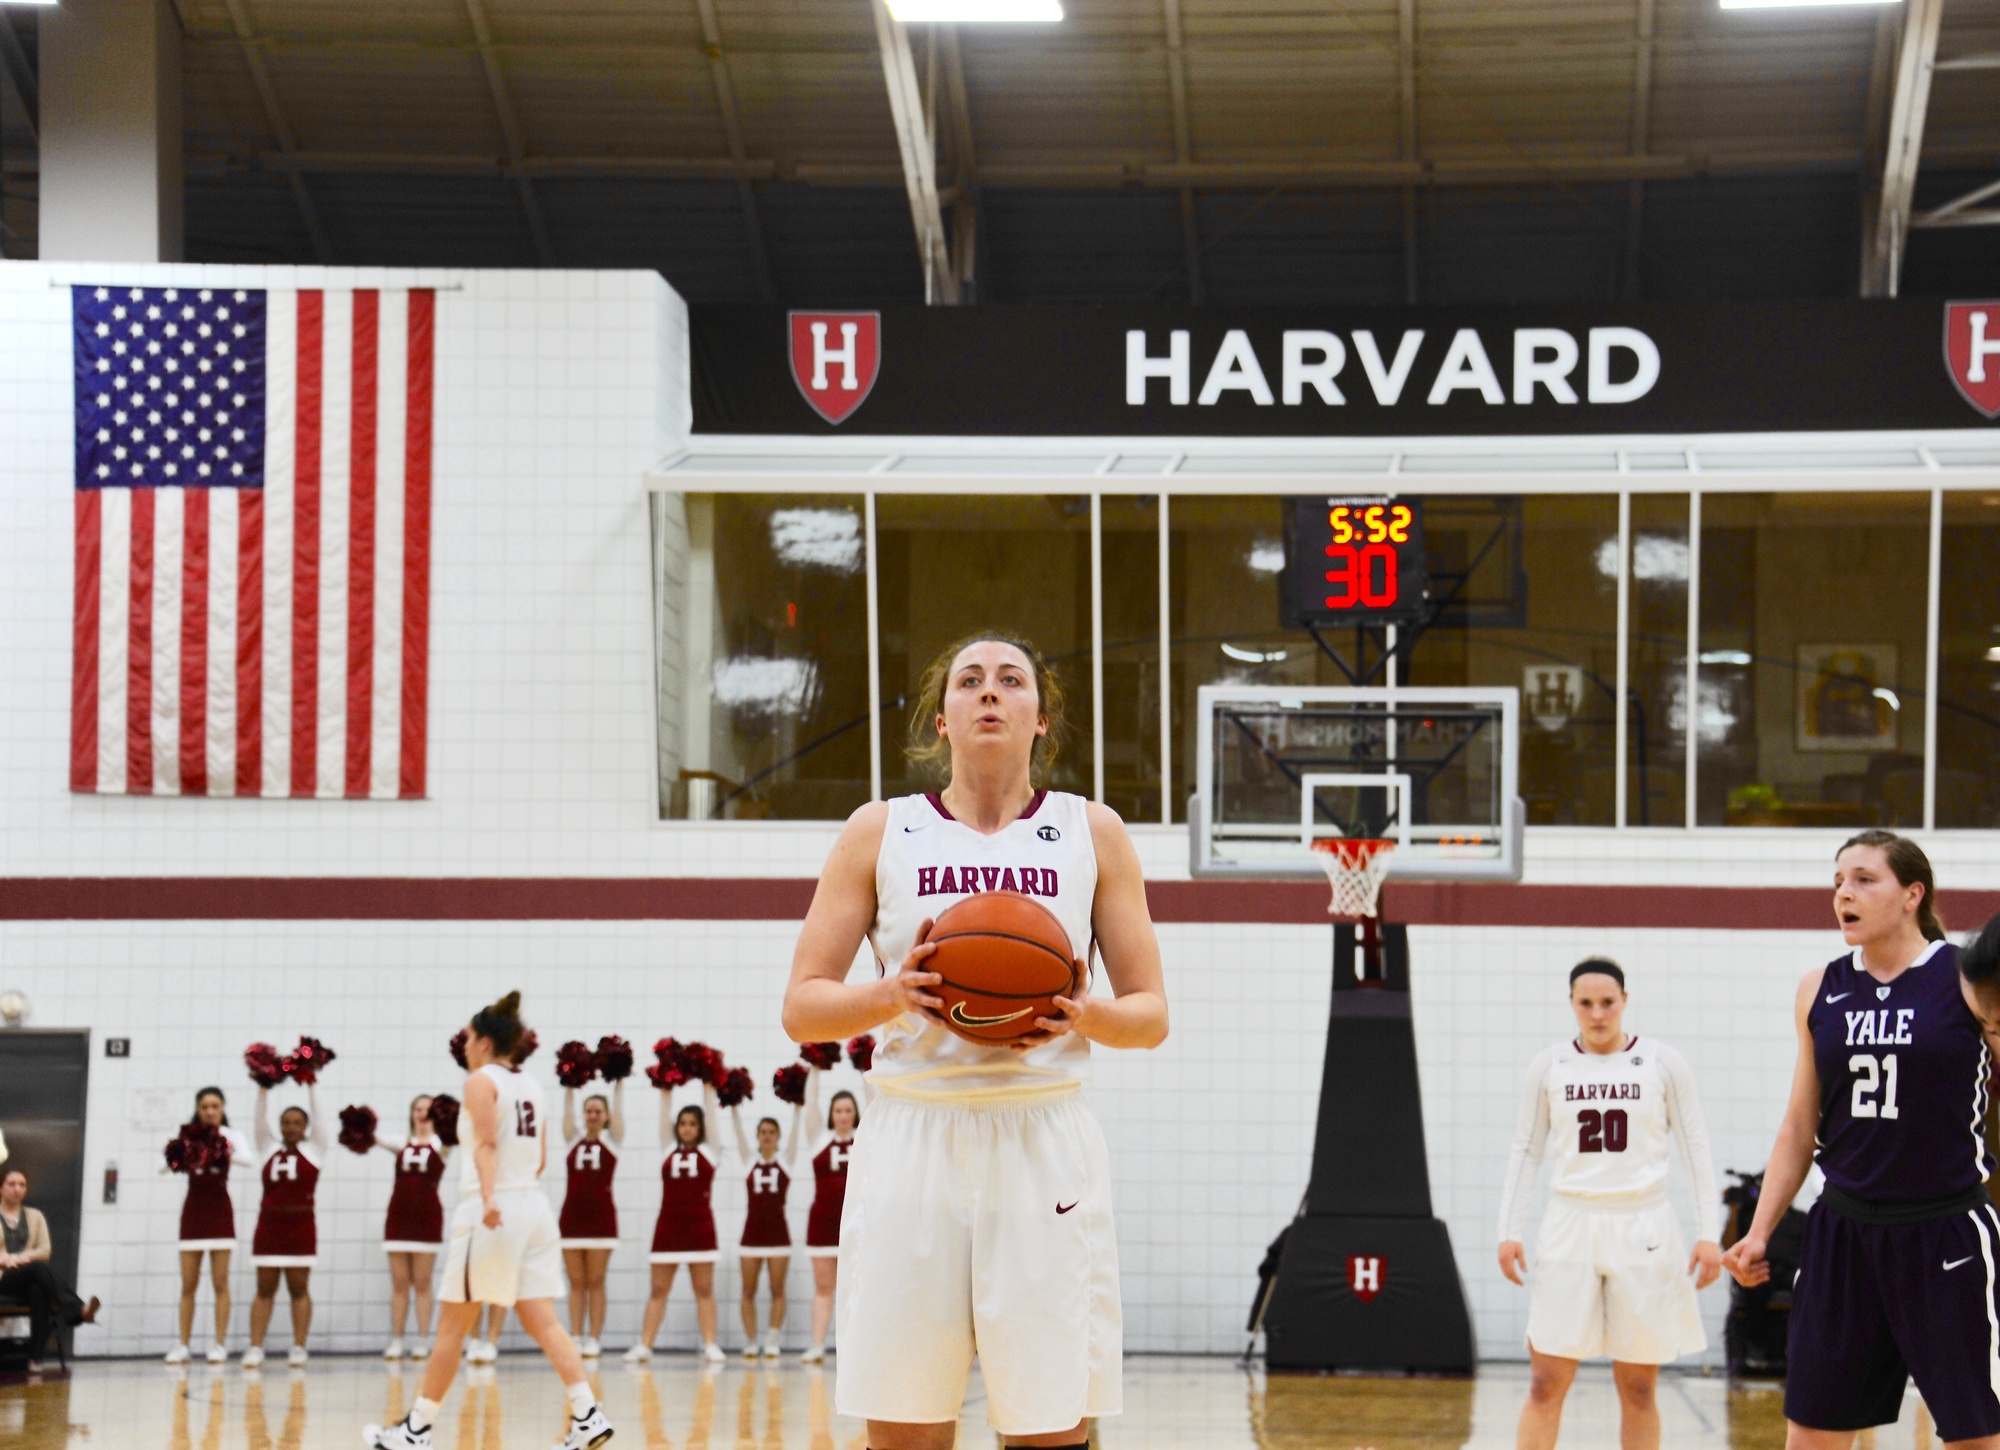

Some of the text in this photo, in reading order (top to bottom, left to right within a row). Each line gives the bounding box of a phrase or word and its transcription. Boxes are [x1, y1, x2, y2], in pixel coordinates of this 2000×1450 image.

[811, 322, 858, 390] H
[1126, 327, 1661, 406] HARVARD
[1329, 505, 1412, 544] 5:52
[1325, 543, 1398, 608] 30
[917, 866, 1059, 898] HARVARD
[1845, 1008, 1914, 1046] YALE
[1565, 1083, 1641, 1101] HARVARD
[1849, 1053, 1899, 1120] 21
[516, 1100, 537, 1138] 12
[1577, 1108, 1628, 1153] 20
[270, 1155, 297, 1181] H
[402, 1147, 432, 1172] H
[575, 1144, 601, 1170] H
[670, 1152, 698, 1178] H
[753, 1167, 780, 1194] H
[1354, 1257, 1379, 1291] H
